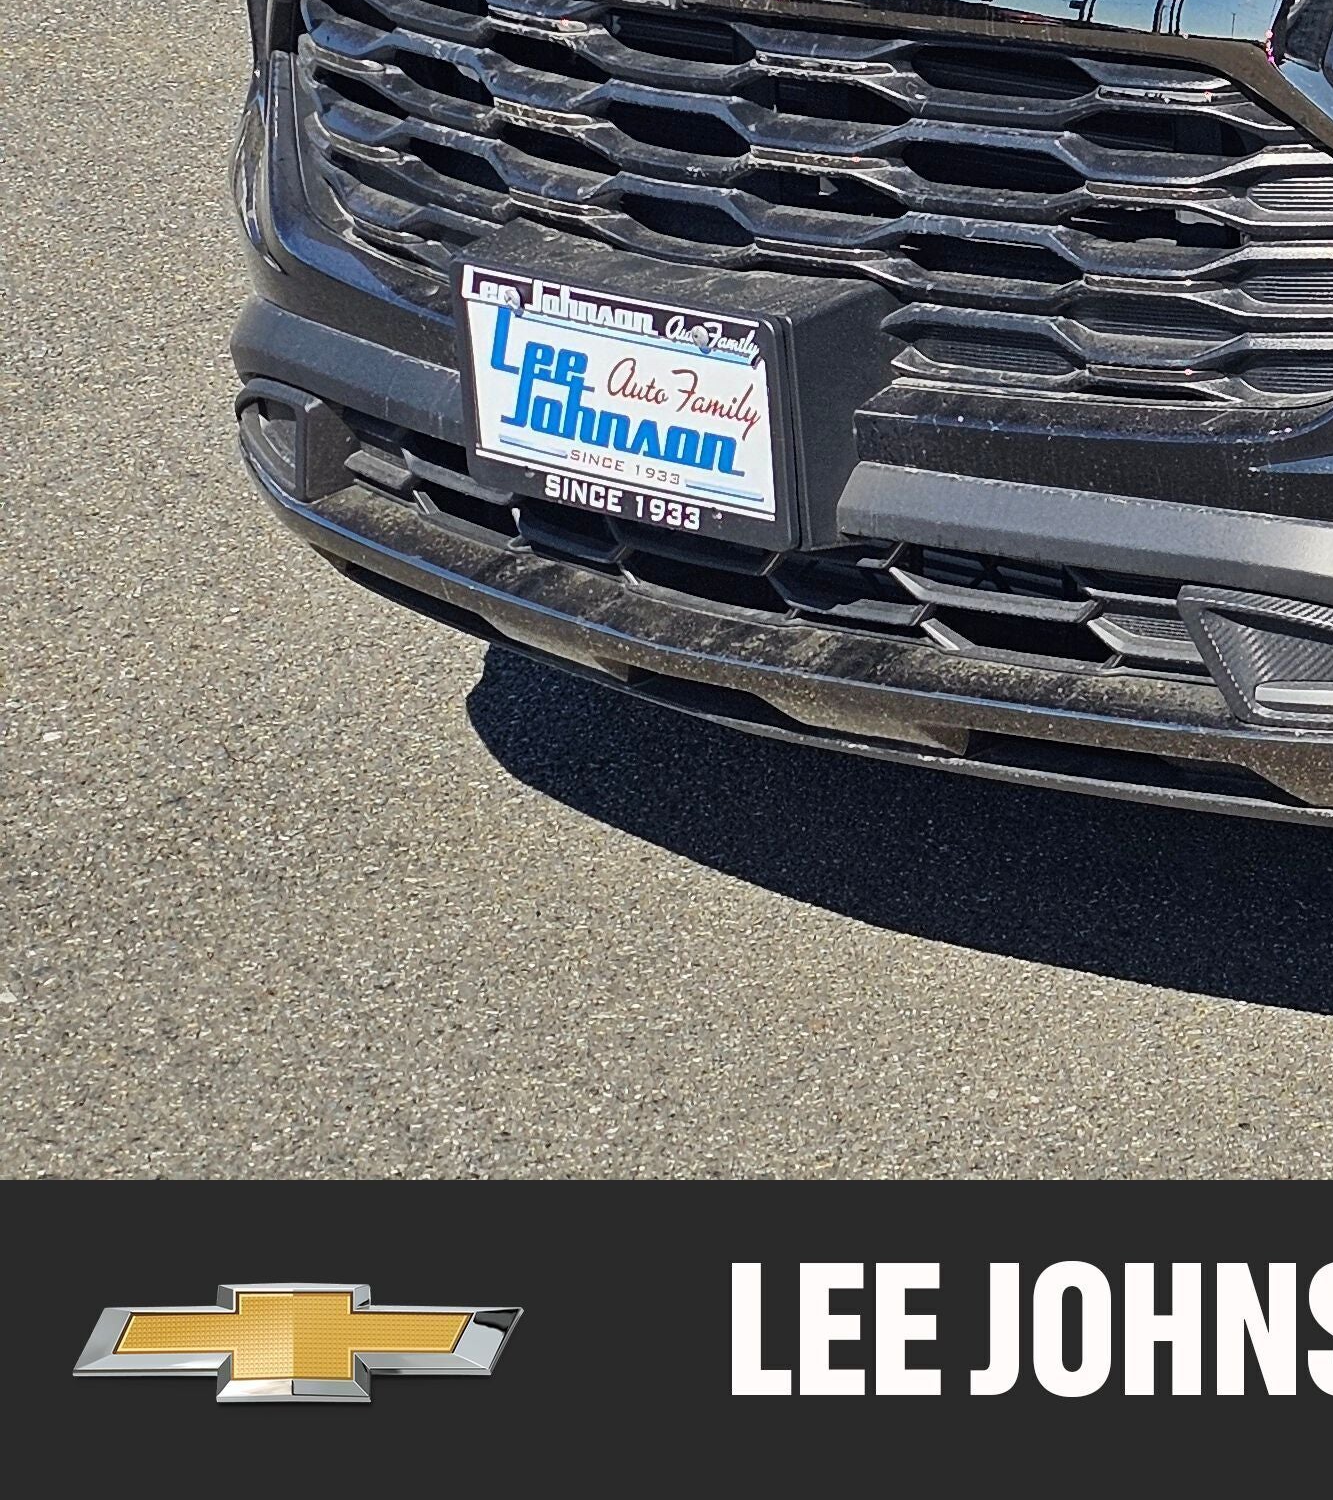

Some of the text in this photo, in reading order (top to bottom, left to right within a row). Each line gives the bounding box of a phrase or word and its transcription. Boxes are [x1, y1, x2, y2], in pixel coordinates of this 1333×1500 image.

[523, 279, 658, 337] Johnson
[702, 321, 760, 366] Family
[490, 302, 761, 441] Lee Auto Family
[500, 366, 746, 478] Johnson
[543, 474, 701, 532] SINCE 1933
[569, 449, 681, 486] SINCE 1933
